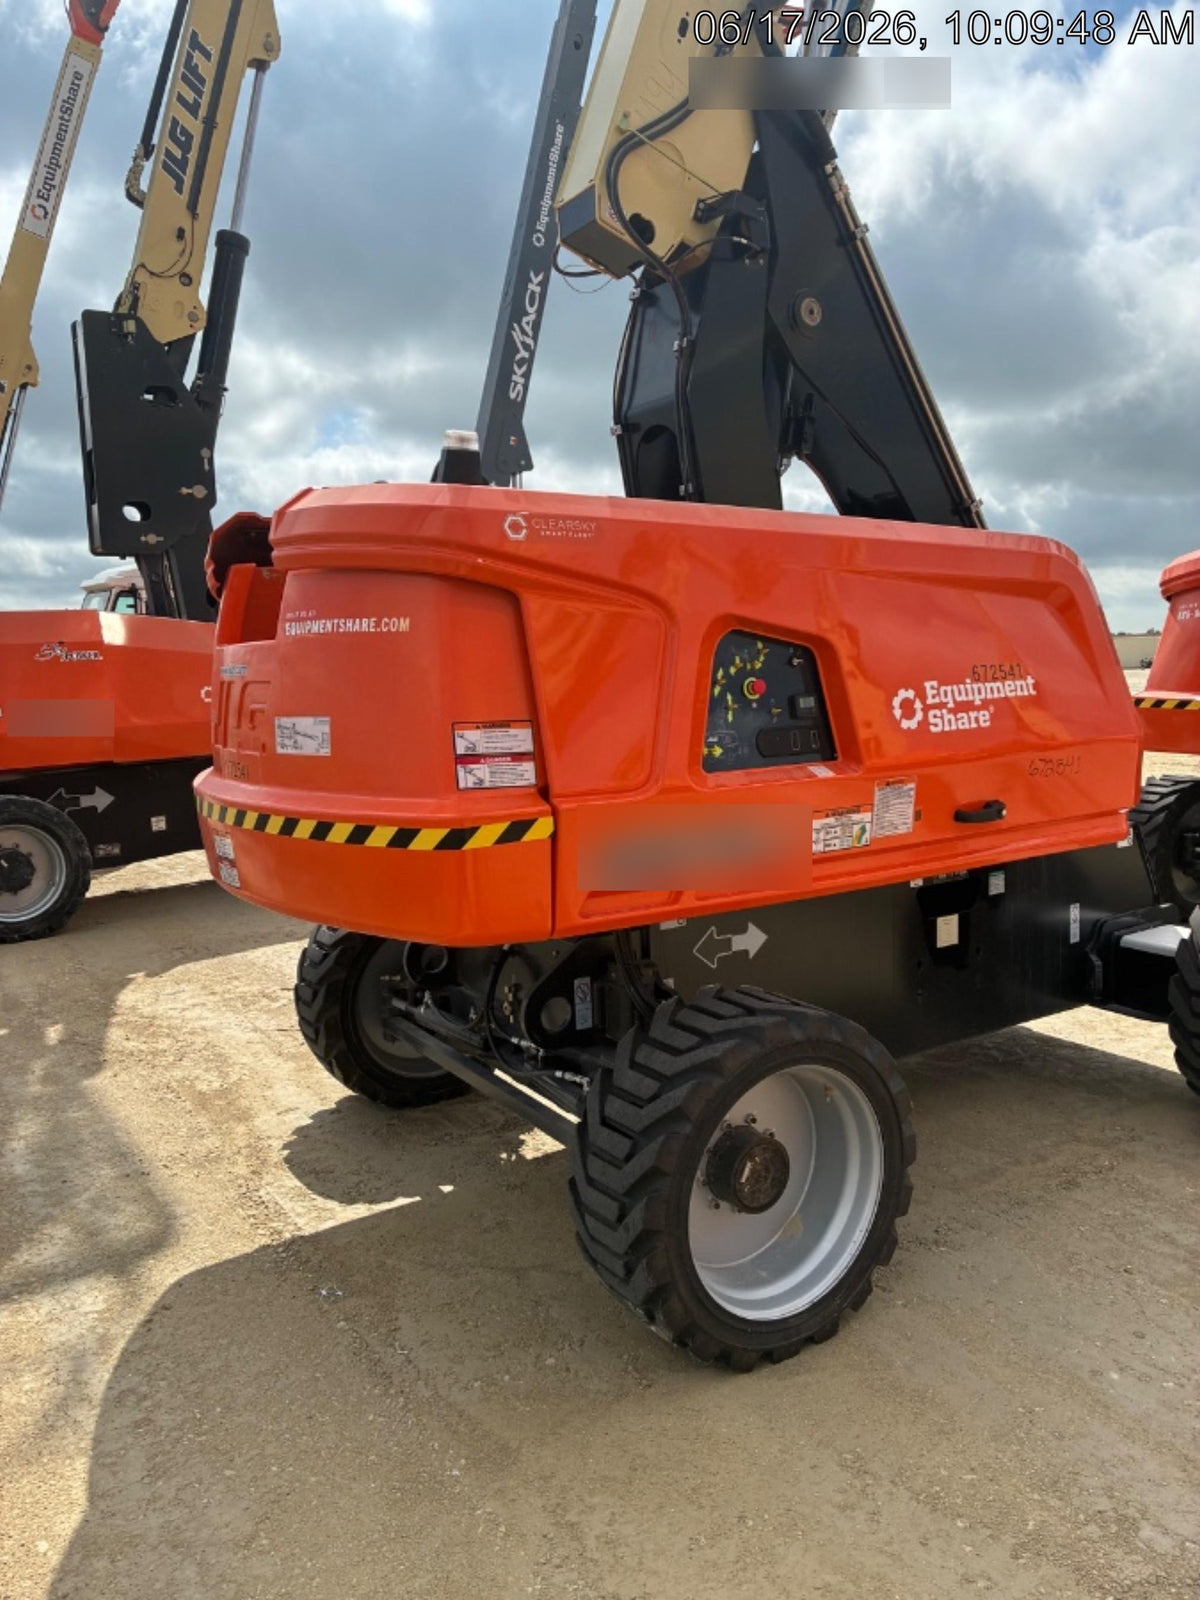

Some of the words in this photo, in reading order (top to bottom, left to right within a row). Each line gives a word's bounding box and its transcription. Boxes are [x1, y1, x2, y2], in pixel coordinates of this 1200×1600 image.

[176, 28, 215, 121] LIFT
[36, 71, 84, 203] EquipmentShare
[161, 115, 194, 196] JLG
[536, 123, 565, 232] EquipmentShare
[509, 270, 544, 402] SKYJACK
[531, 518, 597, 531] CLEARSKY
[285, 616, 411, 636] EQUIPMENTSHARE.COM
[924, 674, 1037, 708] Equipment
[972, 663, 1024, 682] 672541
[927, 708, 991, 733] Share
